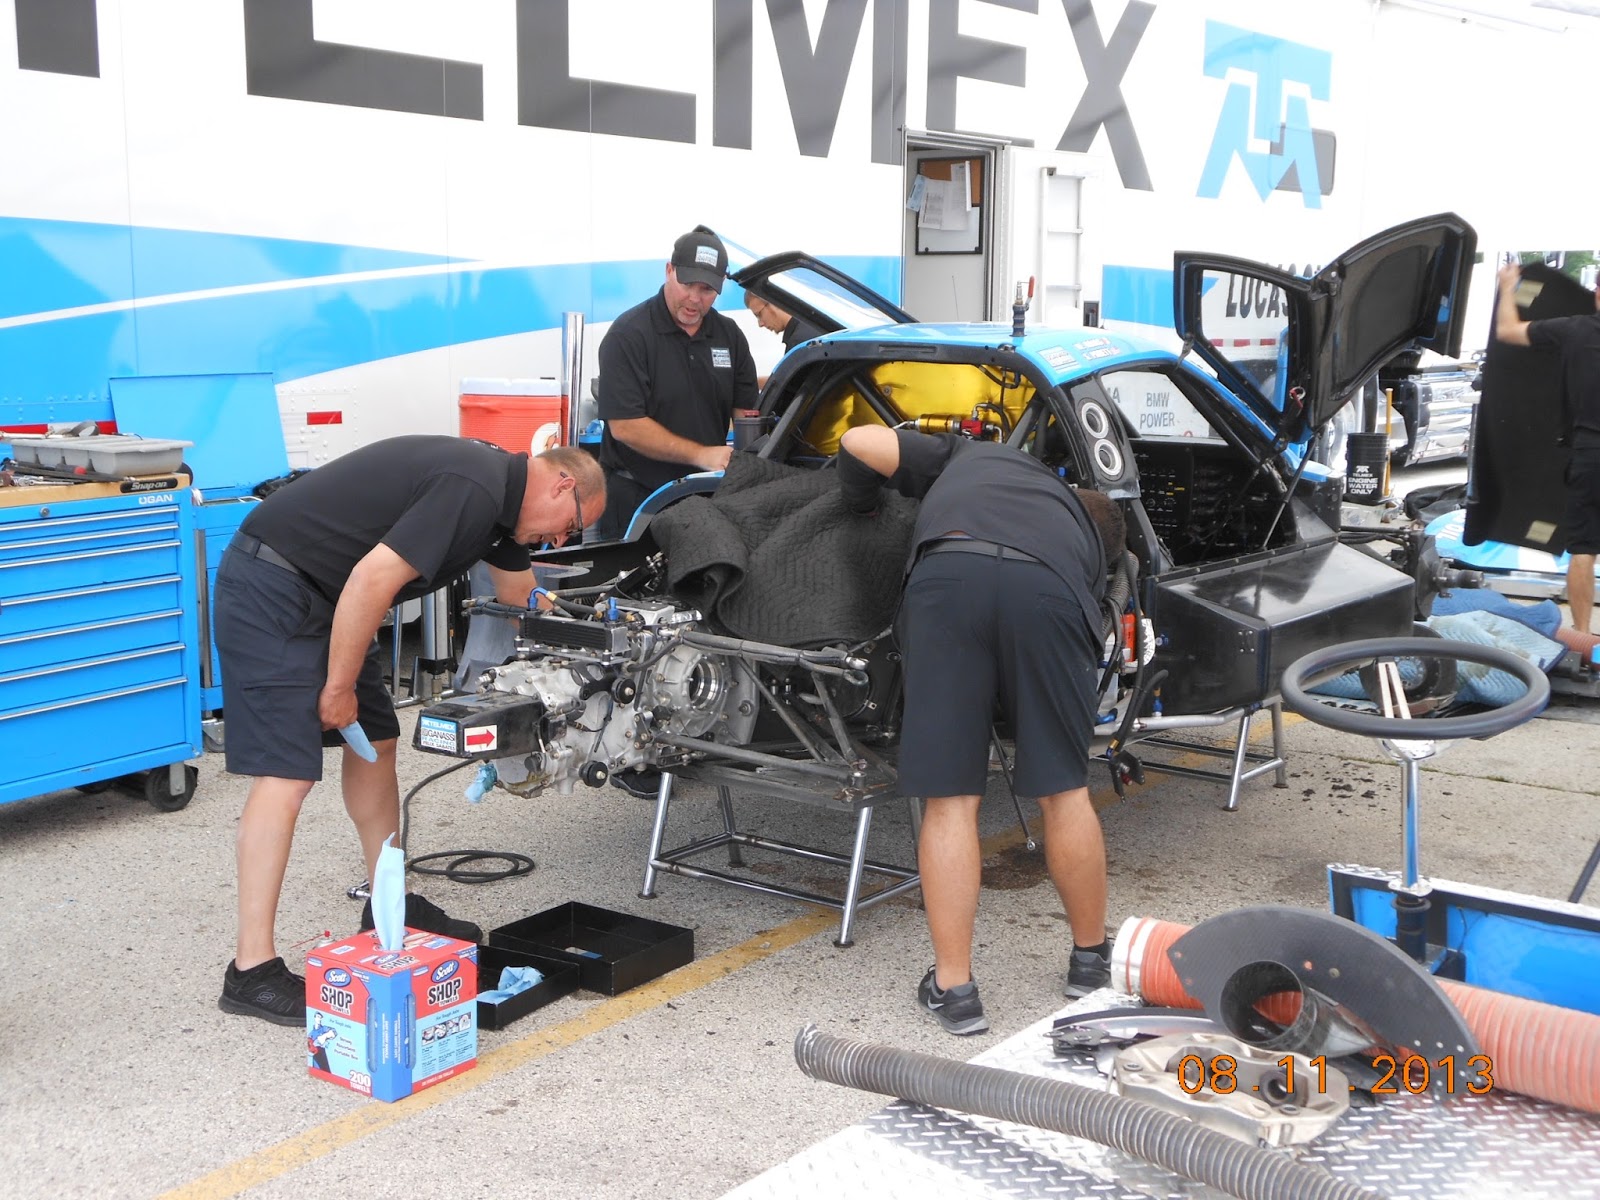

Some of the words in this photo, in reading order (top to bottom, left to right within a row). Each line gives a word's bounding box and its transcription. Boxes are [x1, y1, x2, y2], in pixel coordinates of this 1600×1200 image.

[1146, 392, 1170, 407] BMW
[1140, 412, 1175, 429] POWER
[328, 970, 348, 983] Scott
[435, 961, 455, 981] Scott
[321, 985, 352, 1009] SHOP
[428, 978, 461, 1005] SHOP
[350, 1069, 372, 1087] 200
